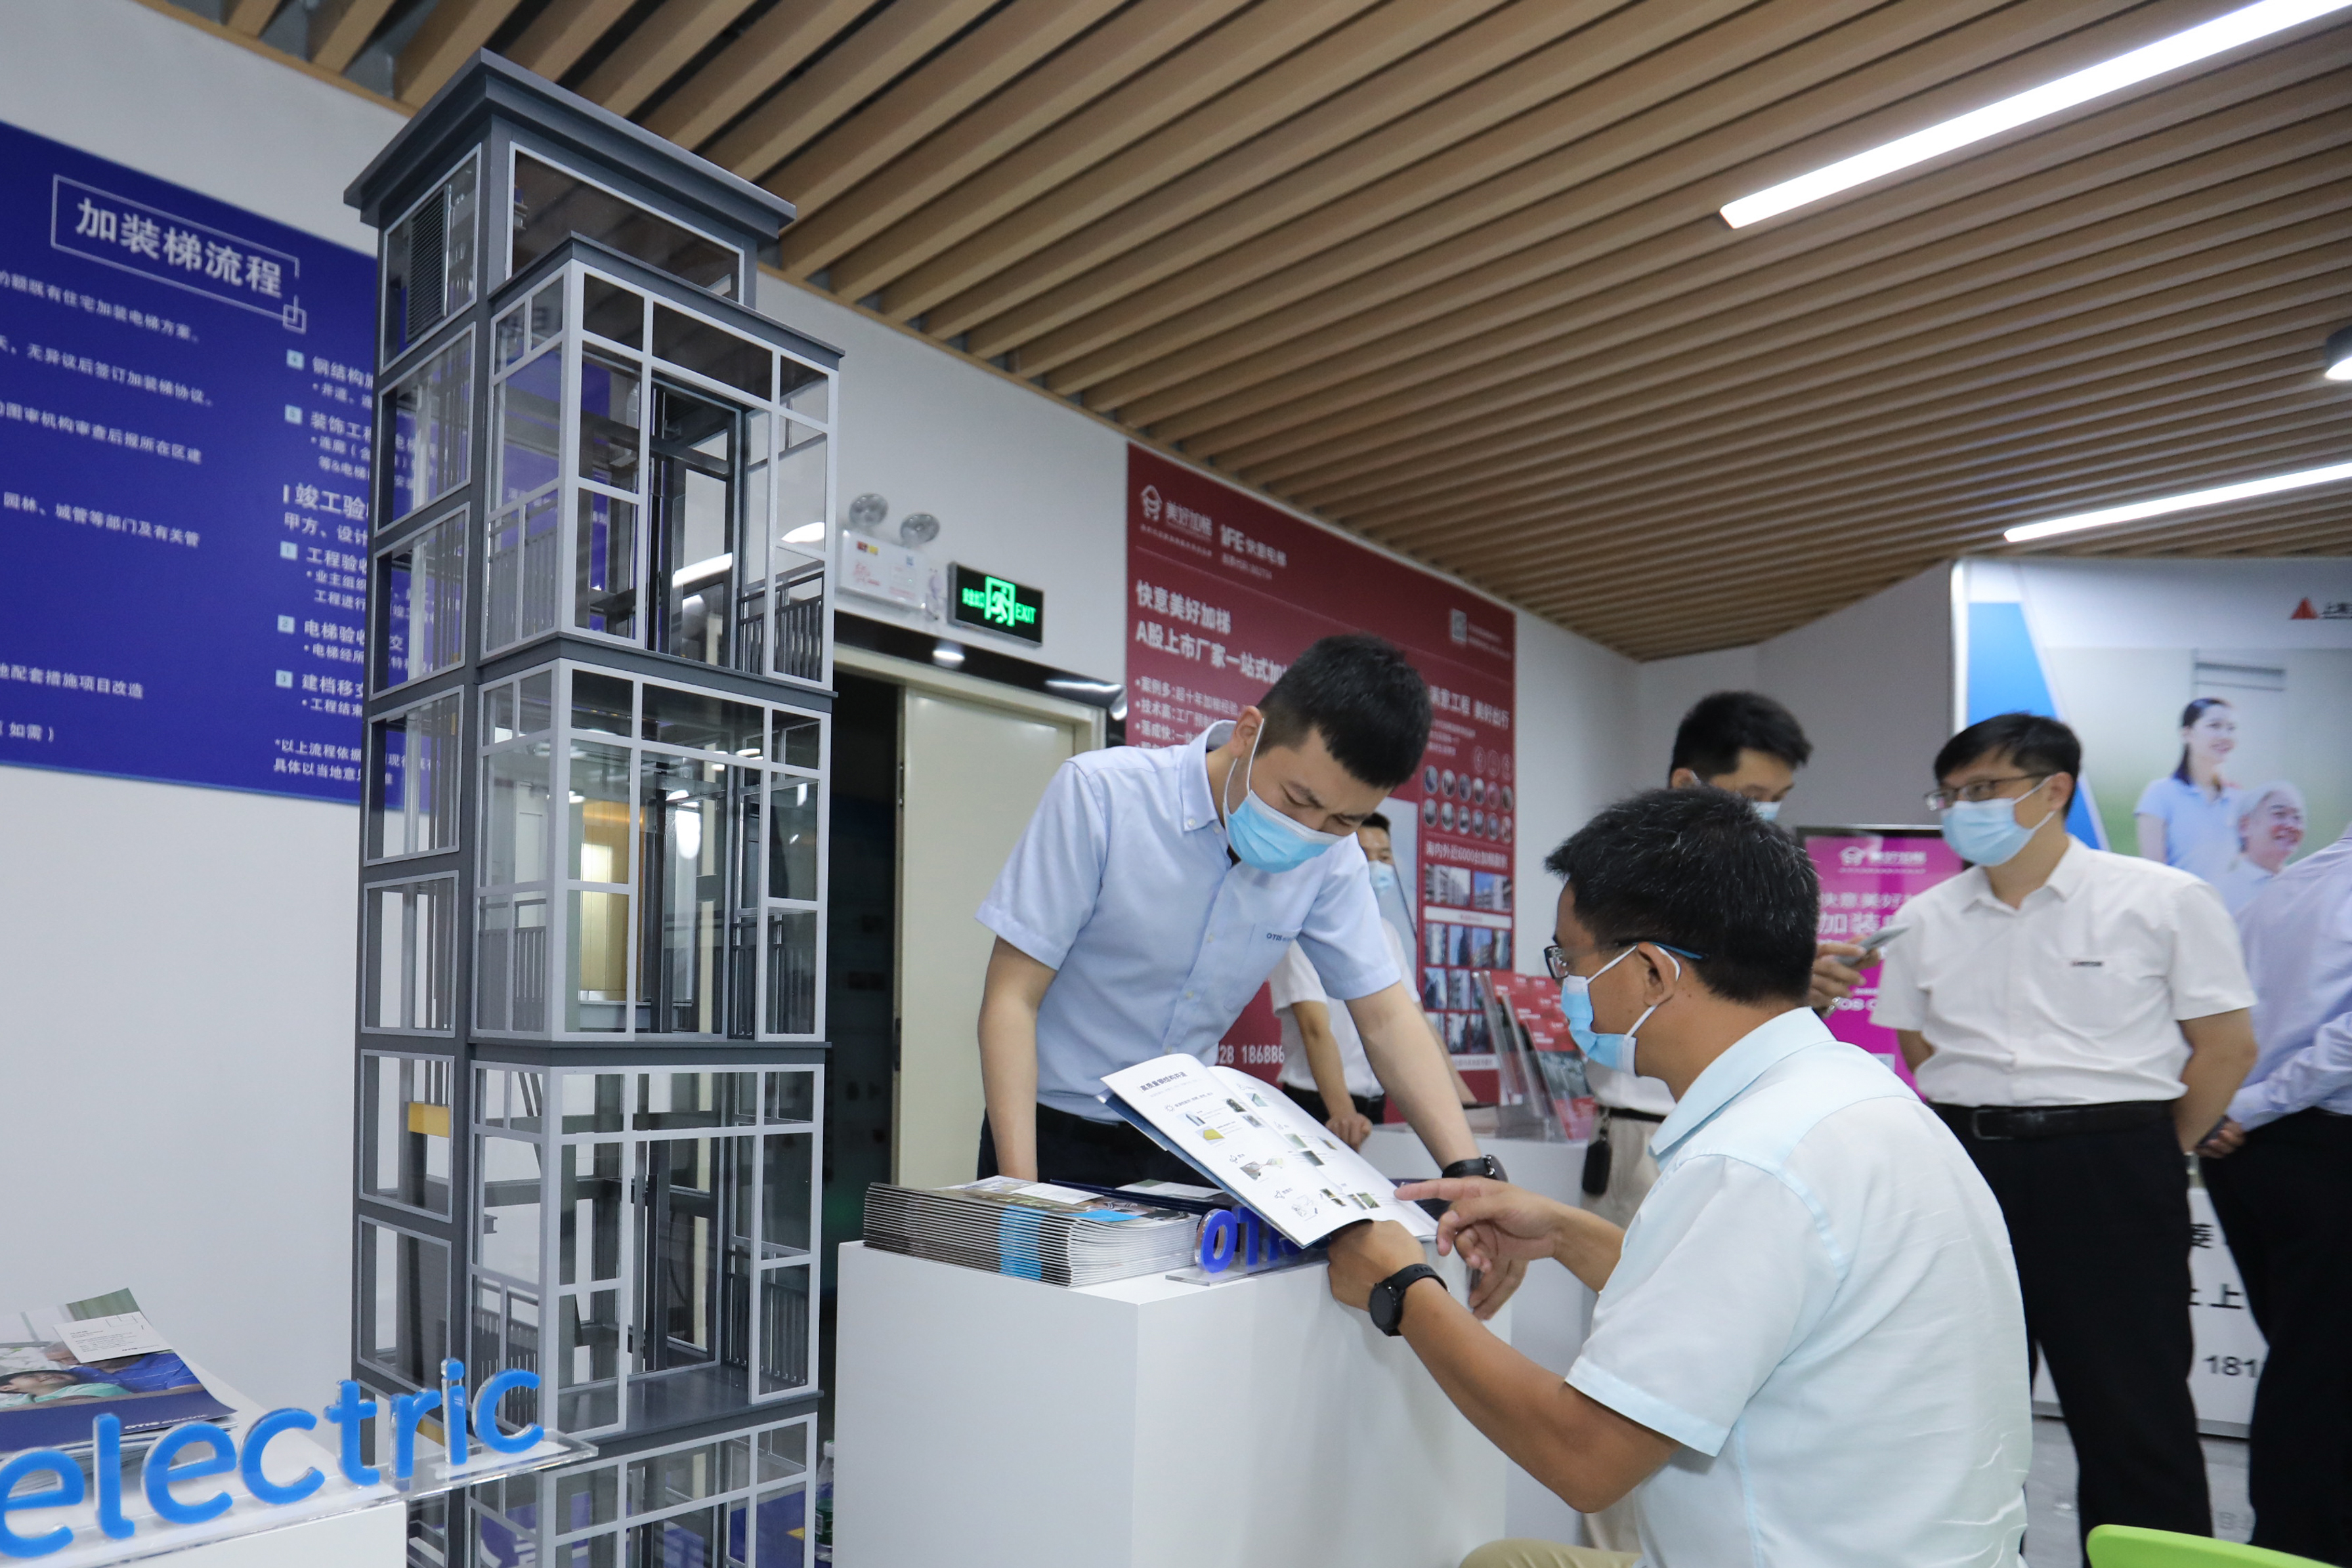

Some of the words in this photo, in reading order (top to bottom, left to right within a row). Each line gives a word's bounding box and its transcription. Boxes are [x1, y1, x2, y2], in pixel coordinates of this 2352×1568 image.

[75, 198, 282, 298] 加装梯流程
[295, 482, 368, 520] 竣工验
[284, 512, 367, 547] 甲方、设计
[1016, 602, 1037, 624] EXIT
[1136, 580, 1231, 635] 快意美好加梯
[1267, 933, 1283, 941] OTIS
[2203, 1354, 2259, 1378] 181
[0, 1357, 545, 1558] electric
